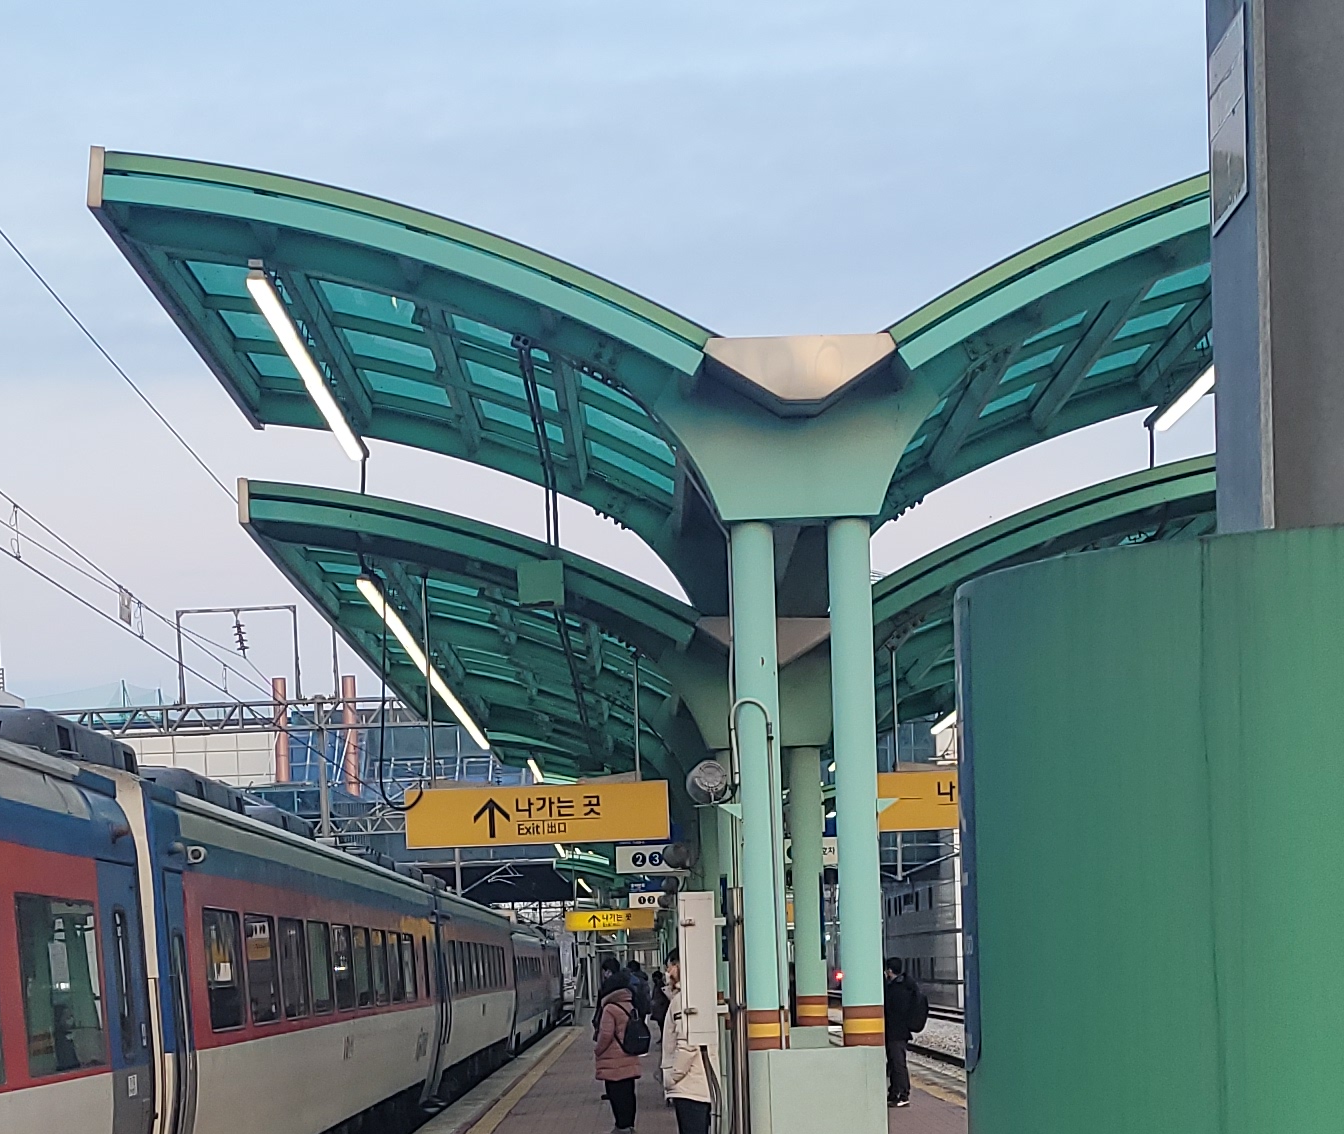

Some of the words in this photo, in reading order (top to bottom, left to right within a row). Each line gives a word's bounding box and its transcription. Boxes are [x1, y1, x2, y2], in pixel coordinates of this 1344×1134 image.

[515, 797, 575, 818] 나가는
[583, 794, 601, 817] 곳
[517, 823, 540, 836] Exit
[547, 822, 567, 834] 出口
